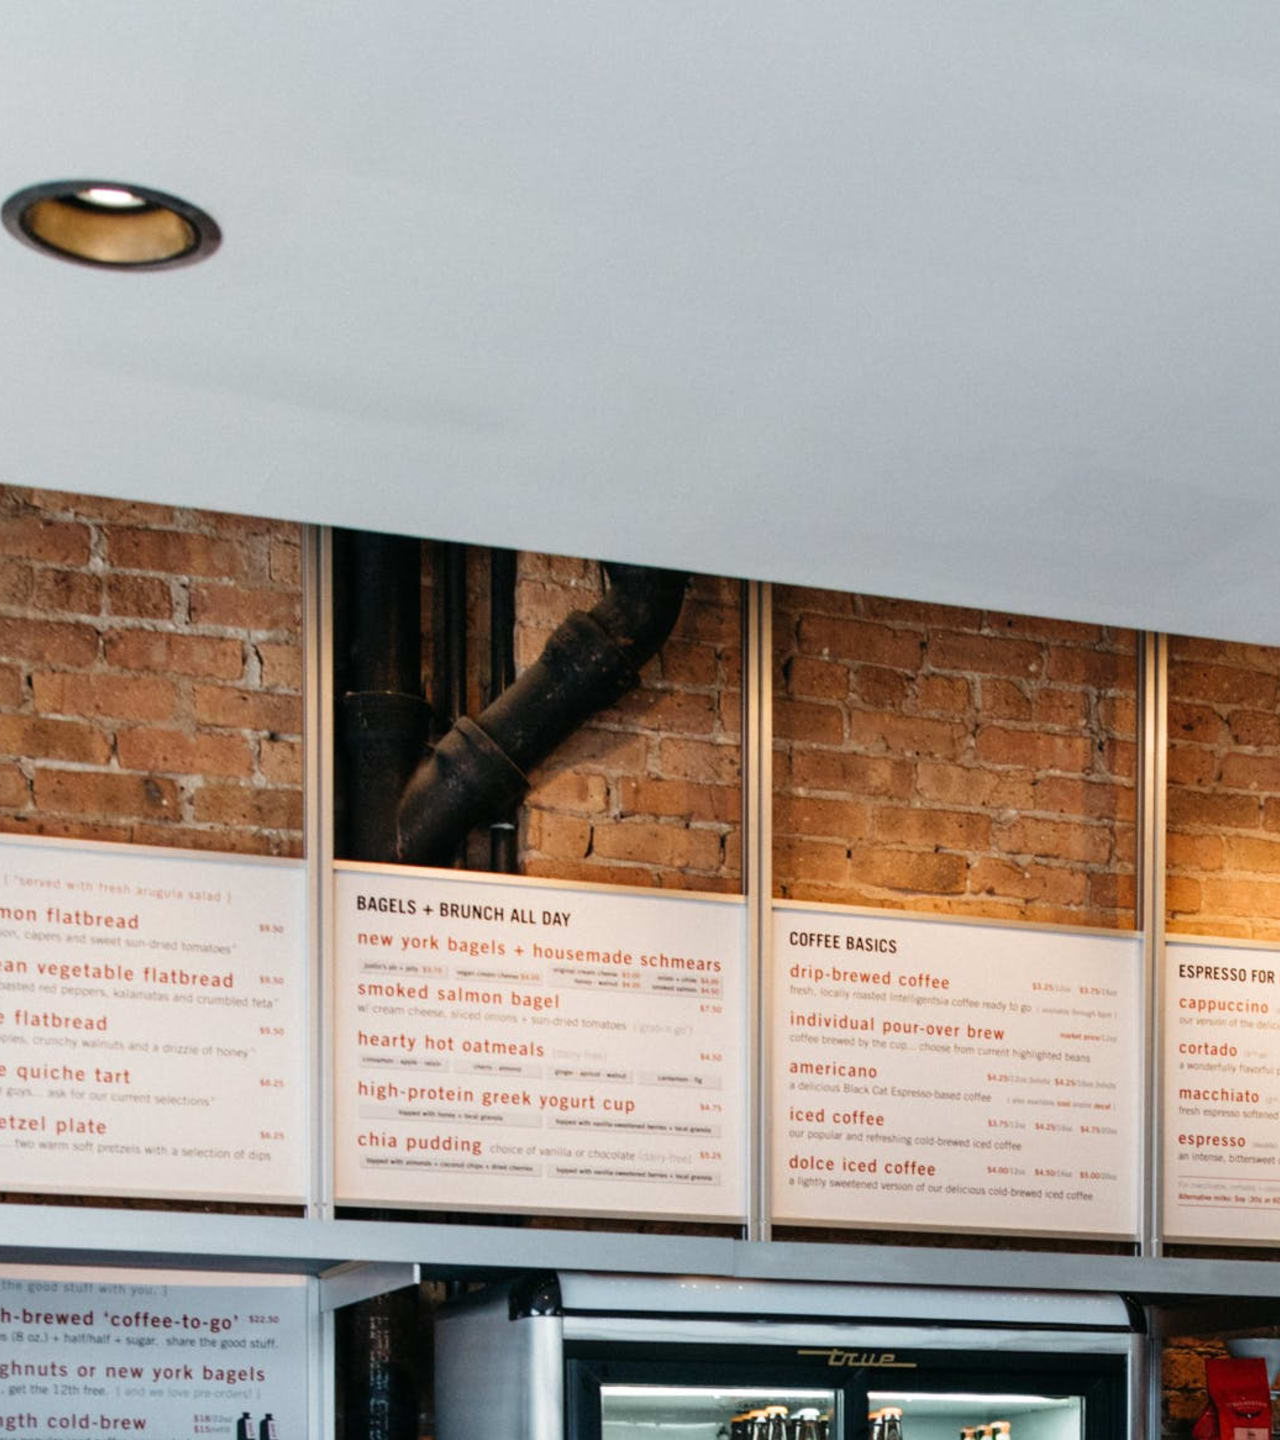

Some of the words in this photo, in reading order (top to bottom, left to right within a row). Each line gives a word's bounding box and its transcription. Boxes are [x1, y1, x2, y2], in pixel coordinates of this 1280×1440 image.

[45, 907, 140, 930] flatbread
[356, 894, 417, 915] BAGELS
[439, 901, 504, 922] BRUNCH
[510, 908, 536, 925] ALL
[542, 910, 571, 927] DAY
[356, 932, 393, 947] new
[401, 935, 439, 950] york
[447, 935, 505, 958] bagels
[532, 943, 633, 965] housemade
[639, 953, 722, 973] schmears
[789, 931, 841, 950] COFFEE
[845, 936, 897, 954] BASICS
[36, 962, 134, 983] vegetable
[143, 967, 235, 989] flatbread
[789, 963, 892, 986] drip-brewed
[898, 972, 950, 990] coffee
[1178, 963, 1247, 983] ESPRESSO
[1251, 969, 1275, 984] FOR
[357, 983, 429, 1001] smoked
[437, 986, 503, 1005] salmon
[509, 991, 560, 1012] bagel
[1178, 997, 1270, 1014] cappuccino
[13, 1008, 109, 1033] flatbread
[789, 1011, 875, 1032] individual
[882, 1019, 961, 1038] pour-over
[966, 1024, 1005, 1041] brew
[357, 1030, 416, 1052] hearty
[424, 1034, 455, 1052] hot
[461, 1039, 545, 1058] oatmeals
[1178, 1042, 1238, 1057] cortado
[15, 1065, 86, 1083] quiche
[93, 1067, 131, 1086] tart
[789, 1061, 878, 1079] americano
[356, 1080, 474, 1105] high-protein
[482, 1090, 533, 1109] greek
[539, 1095, 596, 1112] yogurt
[602, 1098, 636, 1115] cup
[1178, 1087, 1260, 1104] macchiato
[54, 1116, 108, 1137] plate
[789, 1107, 825, 1123] iced
[831, 1110, 885, 1127] coffee
[357, 1131, 399, 1149] chia
[405, 1135, 483, 1157] pudding
[1177, 1133, 1246, 1148] espresso
[788, 1154, 835, 1171] dolce
[842, 1159, 878, 1174] iced
[883, 1160, 937, 1177] coffee
[814, 1347, 906, 1368] true
[77, 1365, 97, 1378] or
[105, 1366, 144, 1379] new
[152, 1364, 193, 1383] york
[201, 1365, 266, 1385] bagels
[47, 1413, 147, 1431] cold-brew
